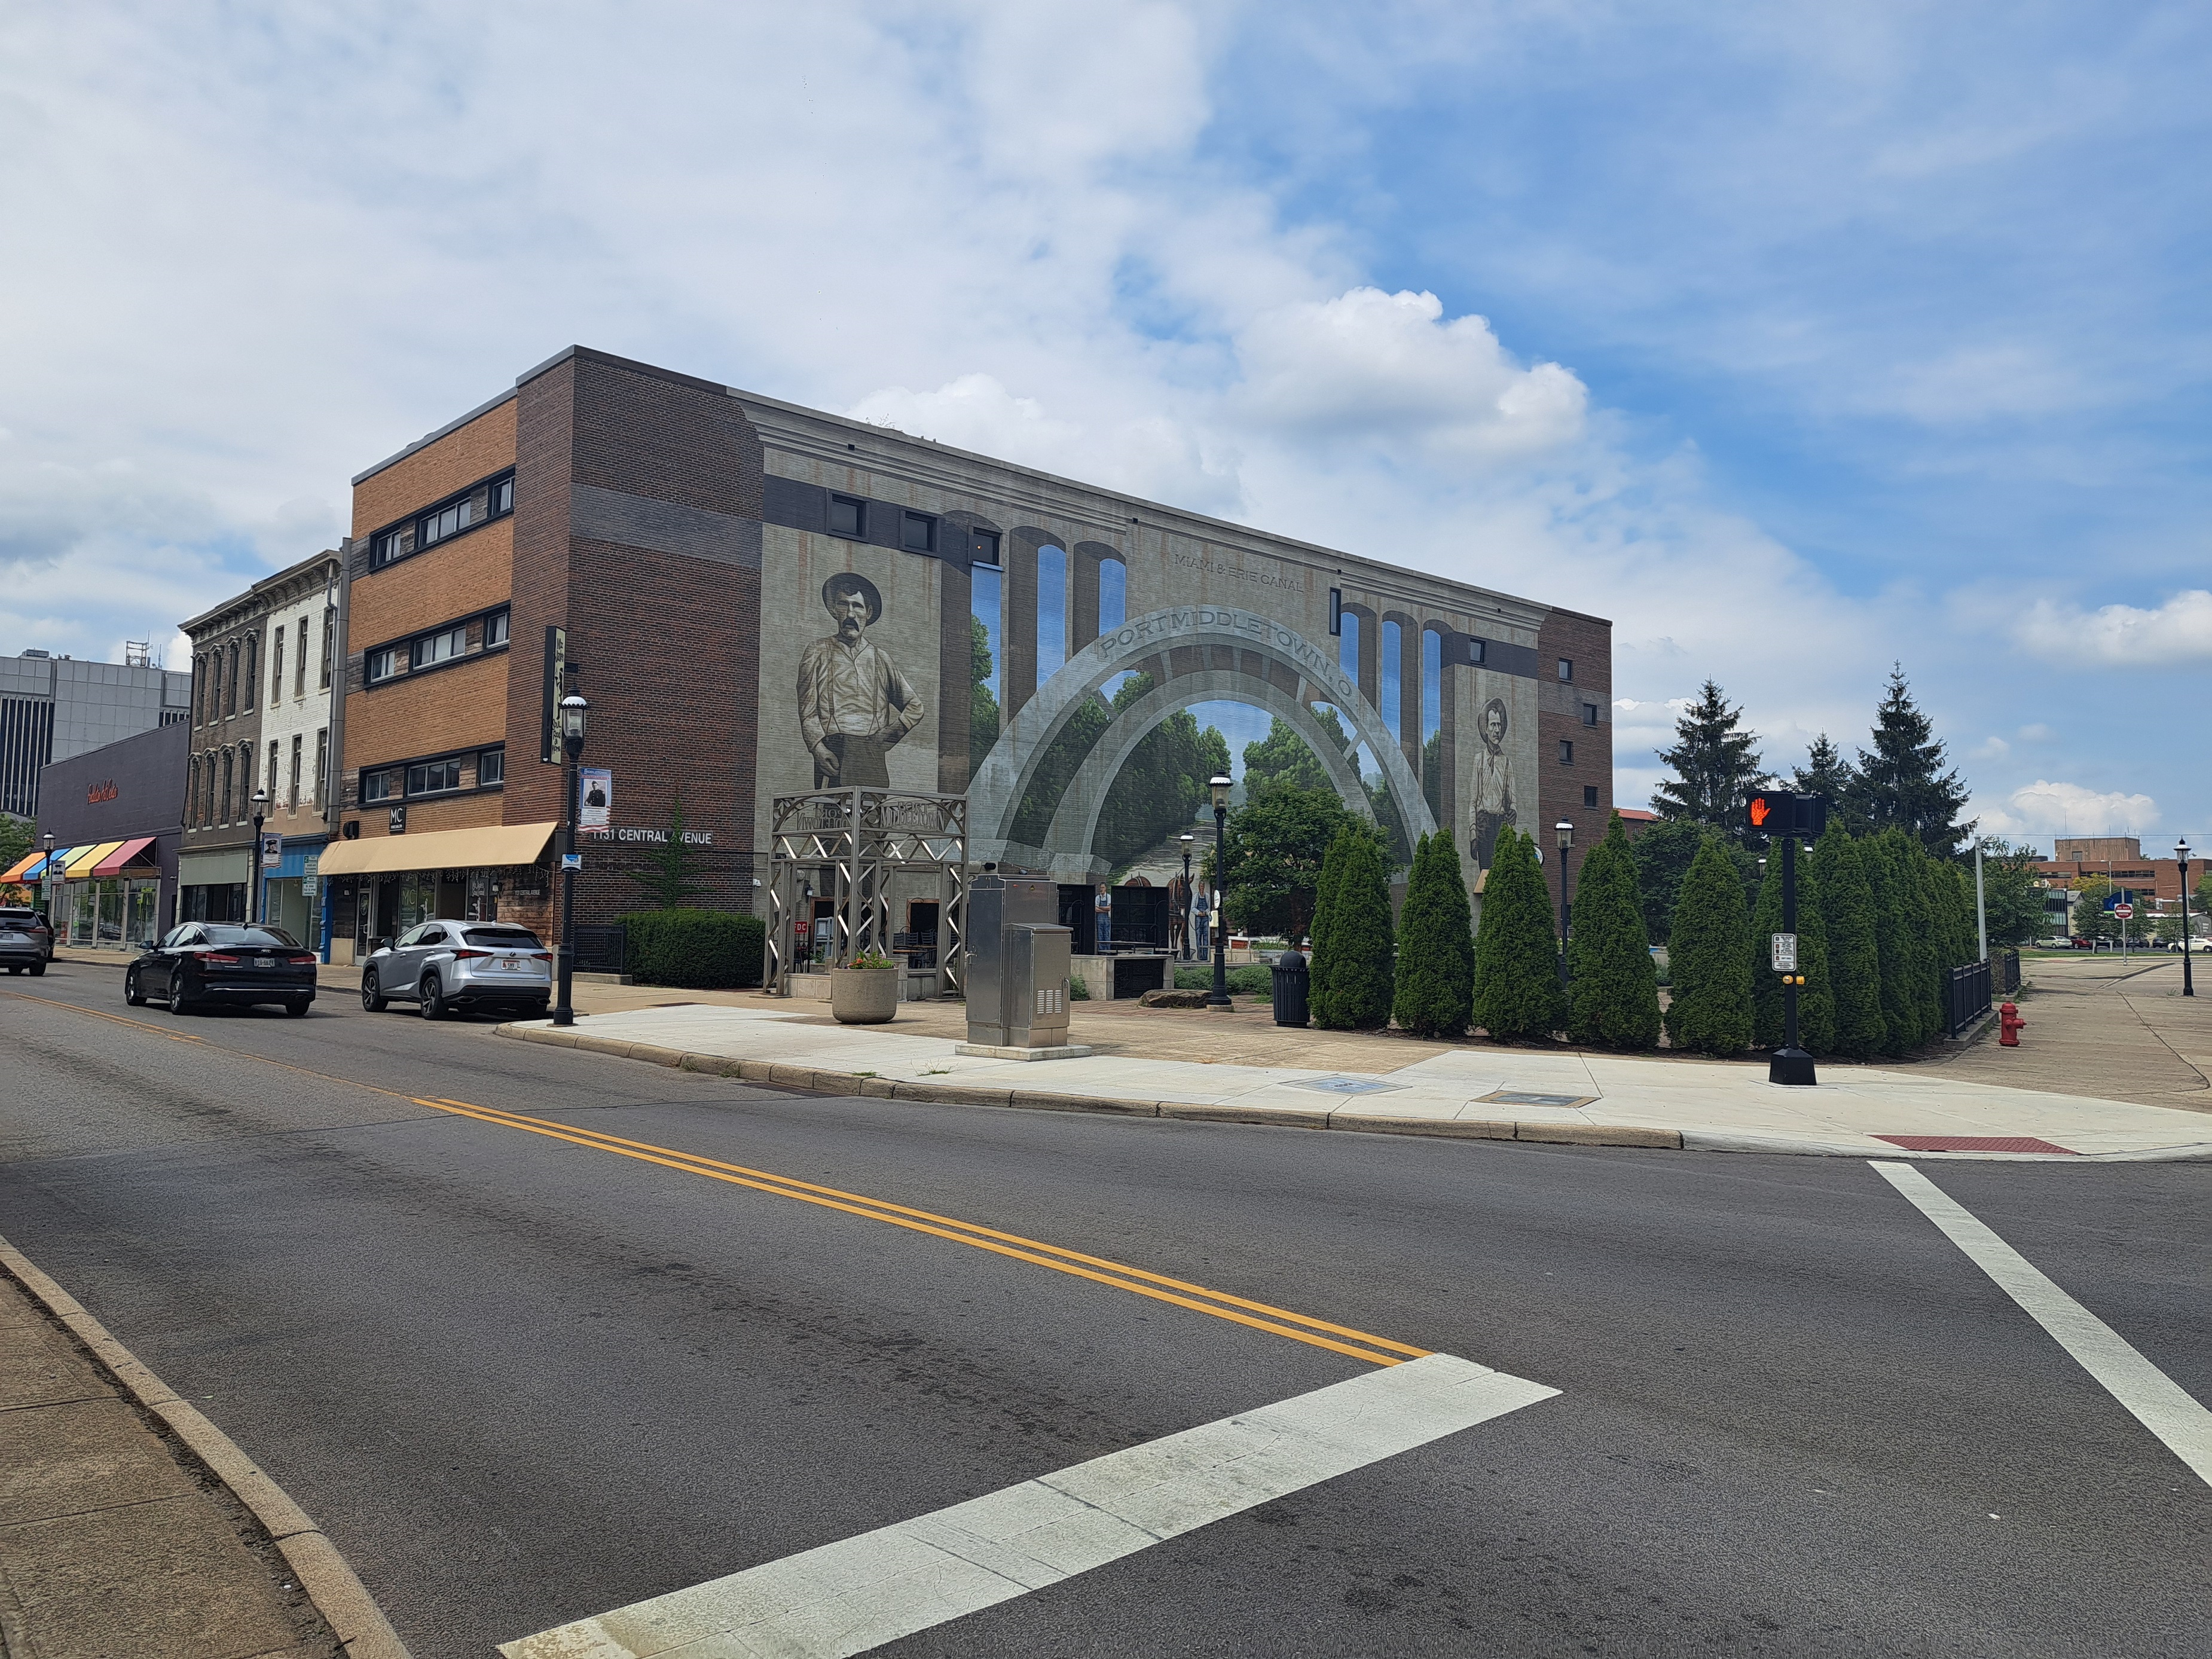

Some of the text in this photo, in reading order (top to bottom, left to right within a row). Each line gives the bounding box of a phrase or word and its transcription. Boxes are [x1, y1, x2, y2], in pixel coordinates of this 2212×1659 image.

[1174, 554, 1304, 593] MIAMI & ERIE CANAL
[390, 808, 403, 824] MC
[618, 829, 668, 842] CENTRAL
[402, 889, 415, 905] MC
